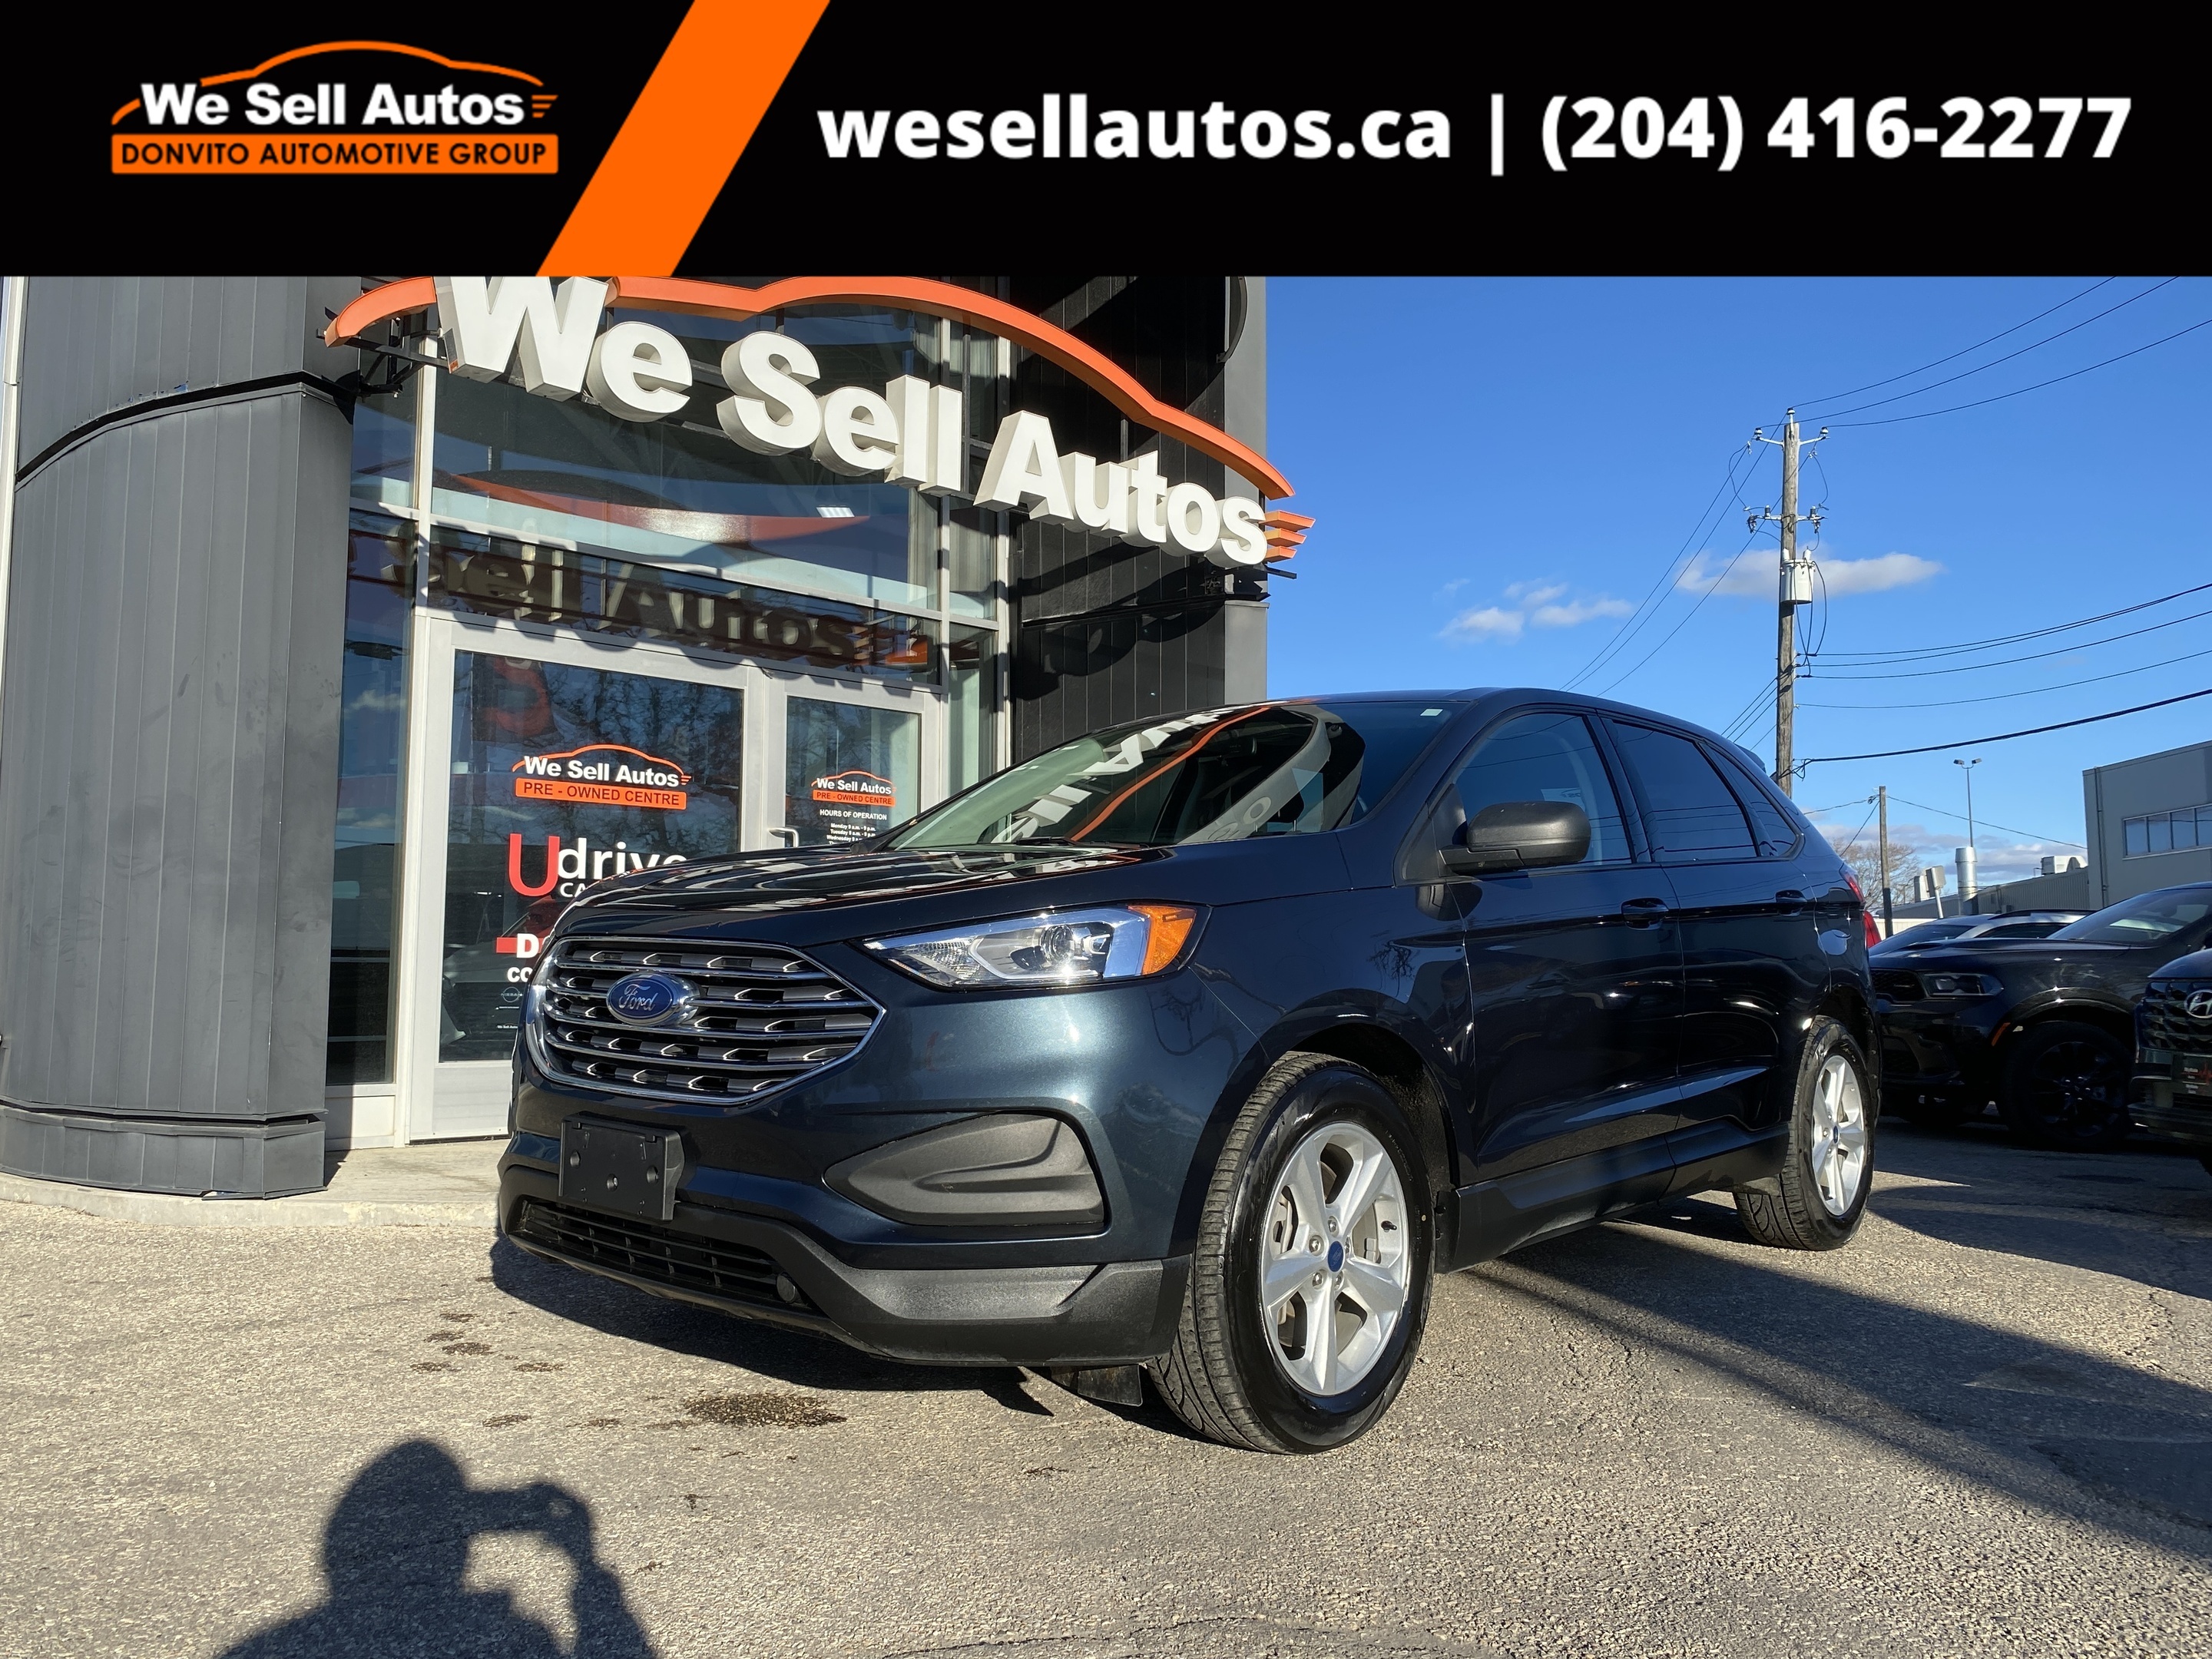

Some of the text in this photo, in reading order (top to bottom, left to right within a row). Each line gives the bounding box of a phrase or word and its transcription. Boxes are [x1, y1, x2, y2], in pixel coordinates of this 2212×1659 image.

[435, 276, 1269, 568] We Sell Autos
[524, 756, 680, 787] We Sell Autos
[524, 782, 553, 796] PRE
[567, 786, 621, 800] OWNED
[624, 790, 680, 806] CENTRE
[816, 777, 892, 794] We Sell Autos
[837, 793, 863, 803] OWNED
[865, 796, 892, 805] CENTRE
[820, 809, 842, 817] HOURS
[853, 811, 887, 820] OPERATION
[826, 834, 852, 843] Wednesday
[618, 983, 658, 1012] Ford
